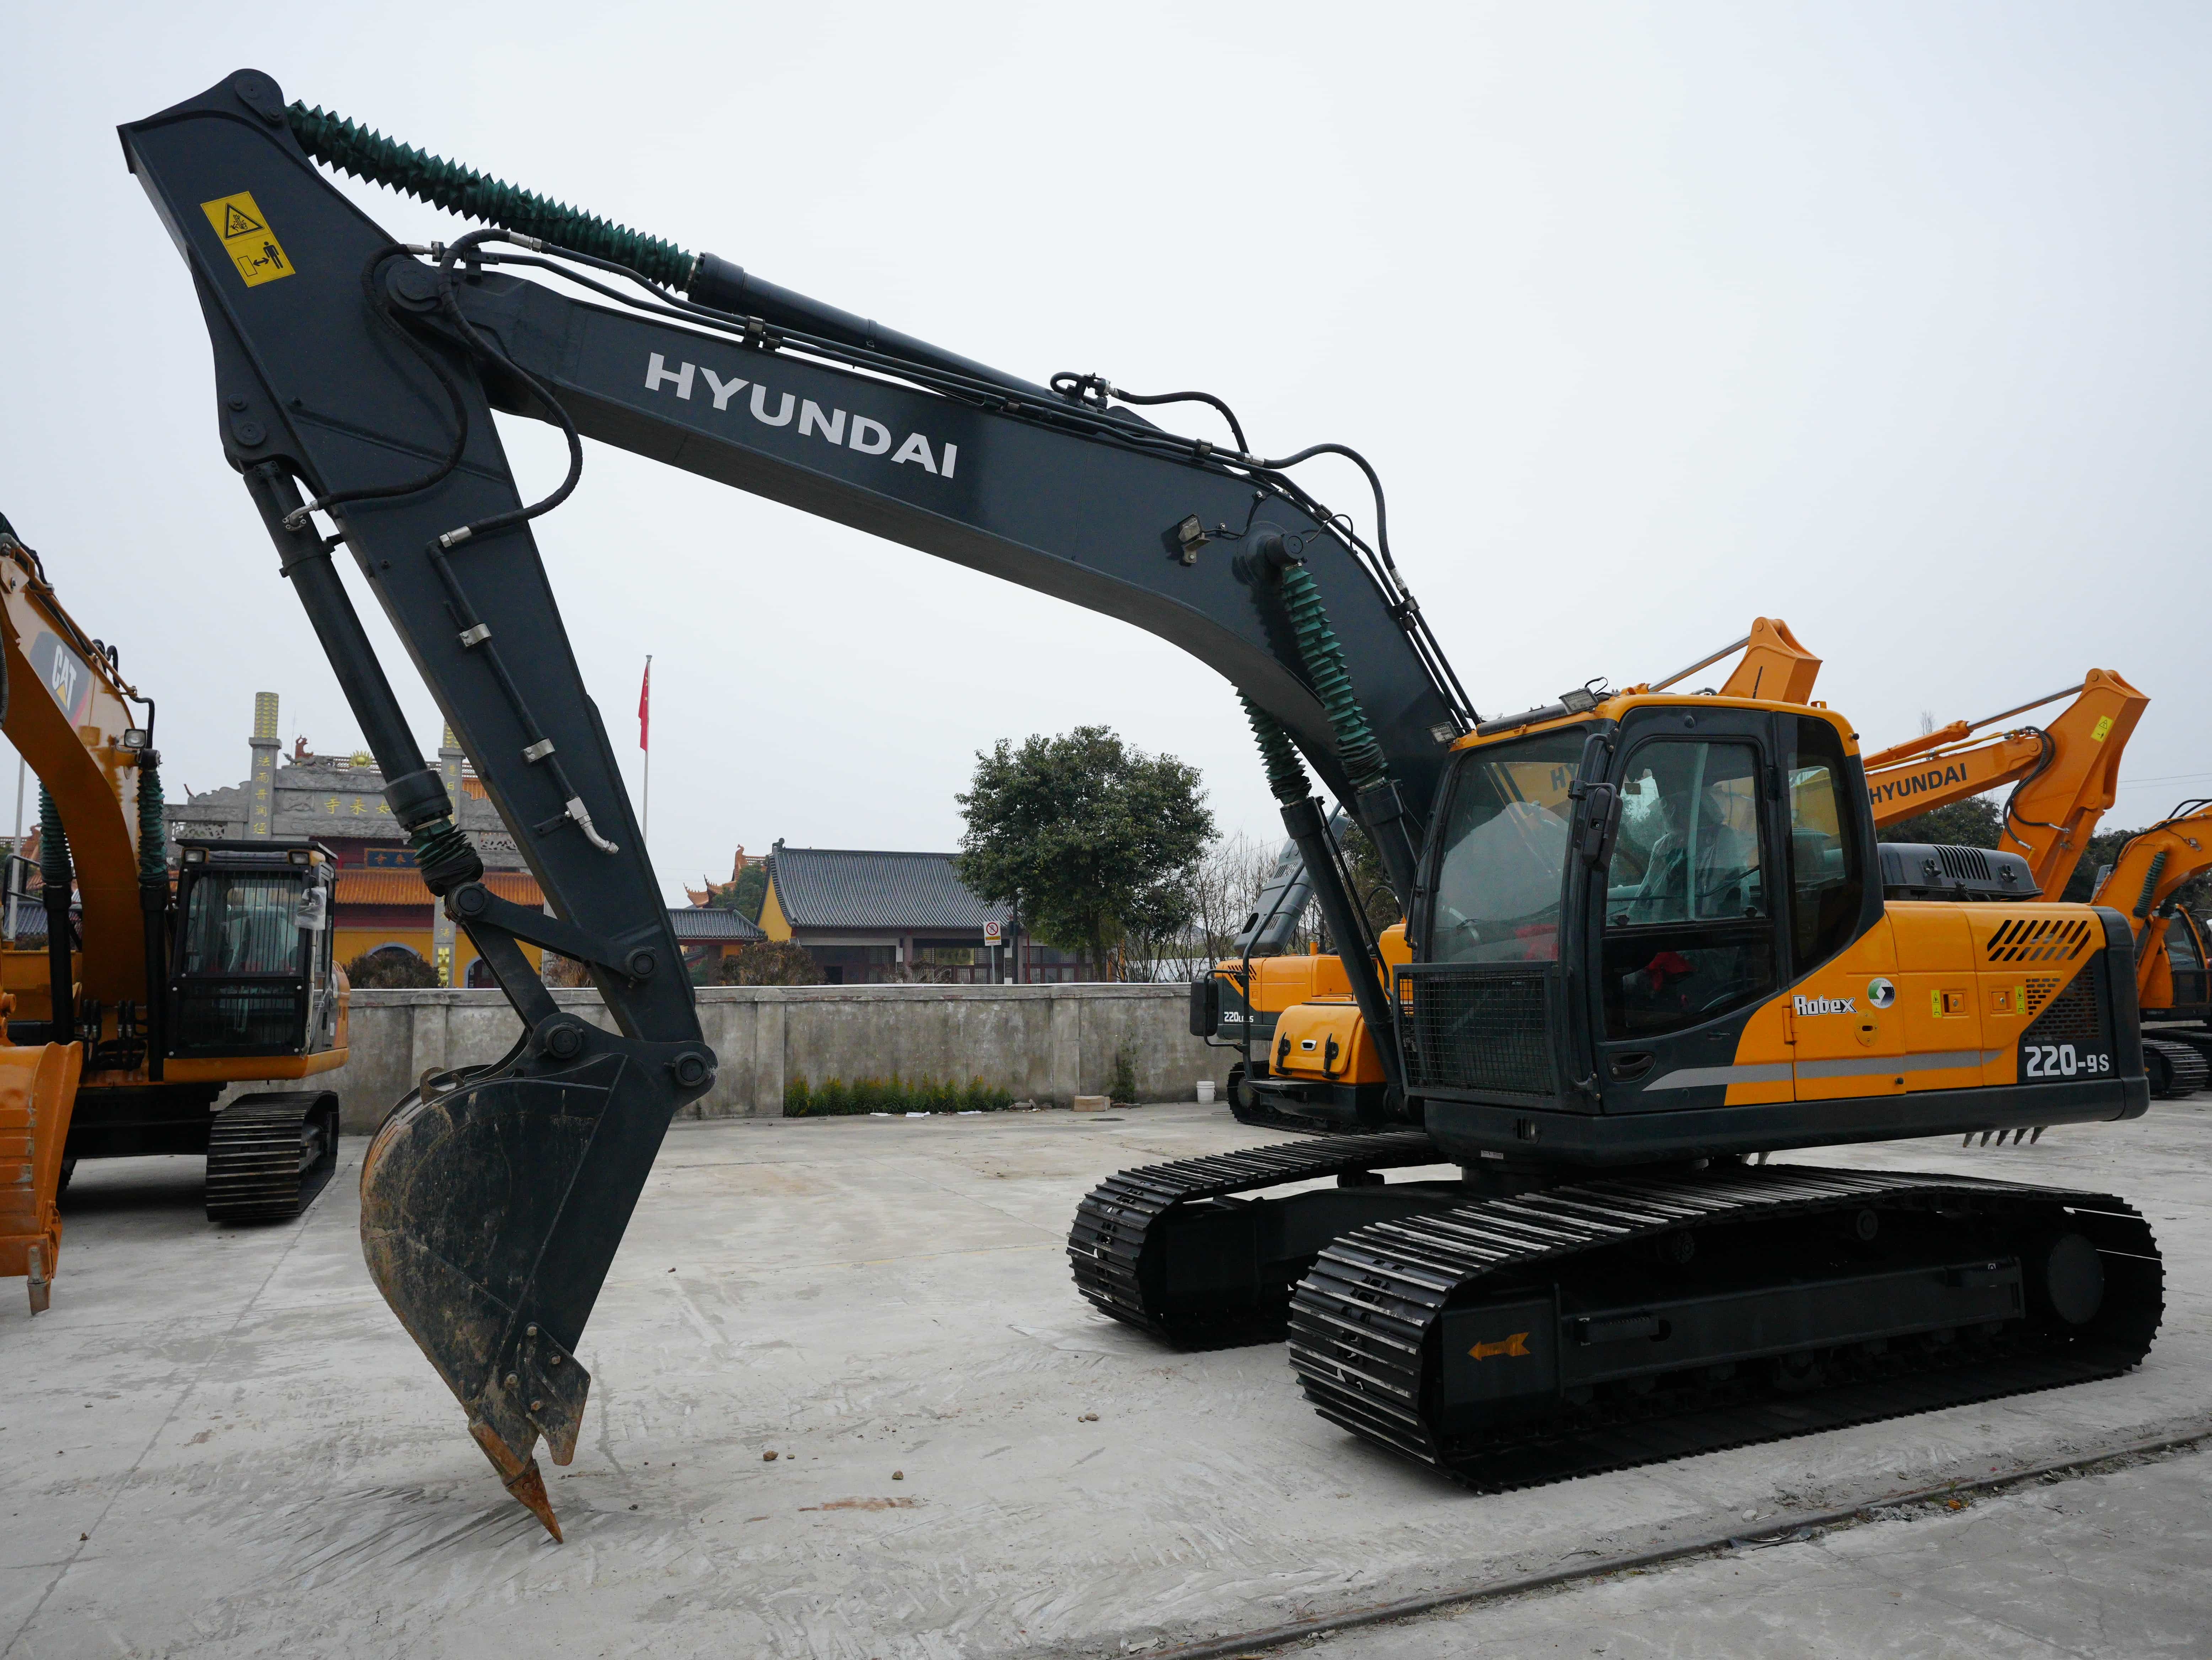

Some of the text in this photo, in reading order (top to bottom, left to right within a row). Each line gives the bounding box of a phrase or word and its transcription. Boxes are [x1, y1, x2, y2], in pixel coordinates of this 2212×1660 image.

[644, 352, 958, 479] HYUNDAI
[52, 645, 77, 711] CAT
[1868, 762, 1967, 805] HYUNDAI
[1793, 994, 1858, 1017] Robex
